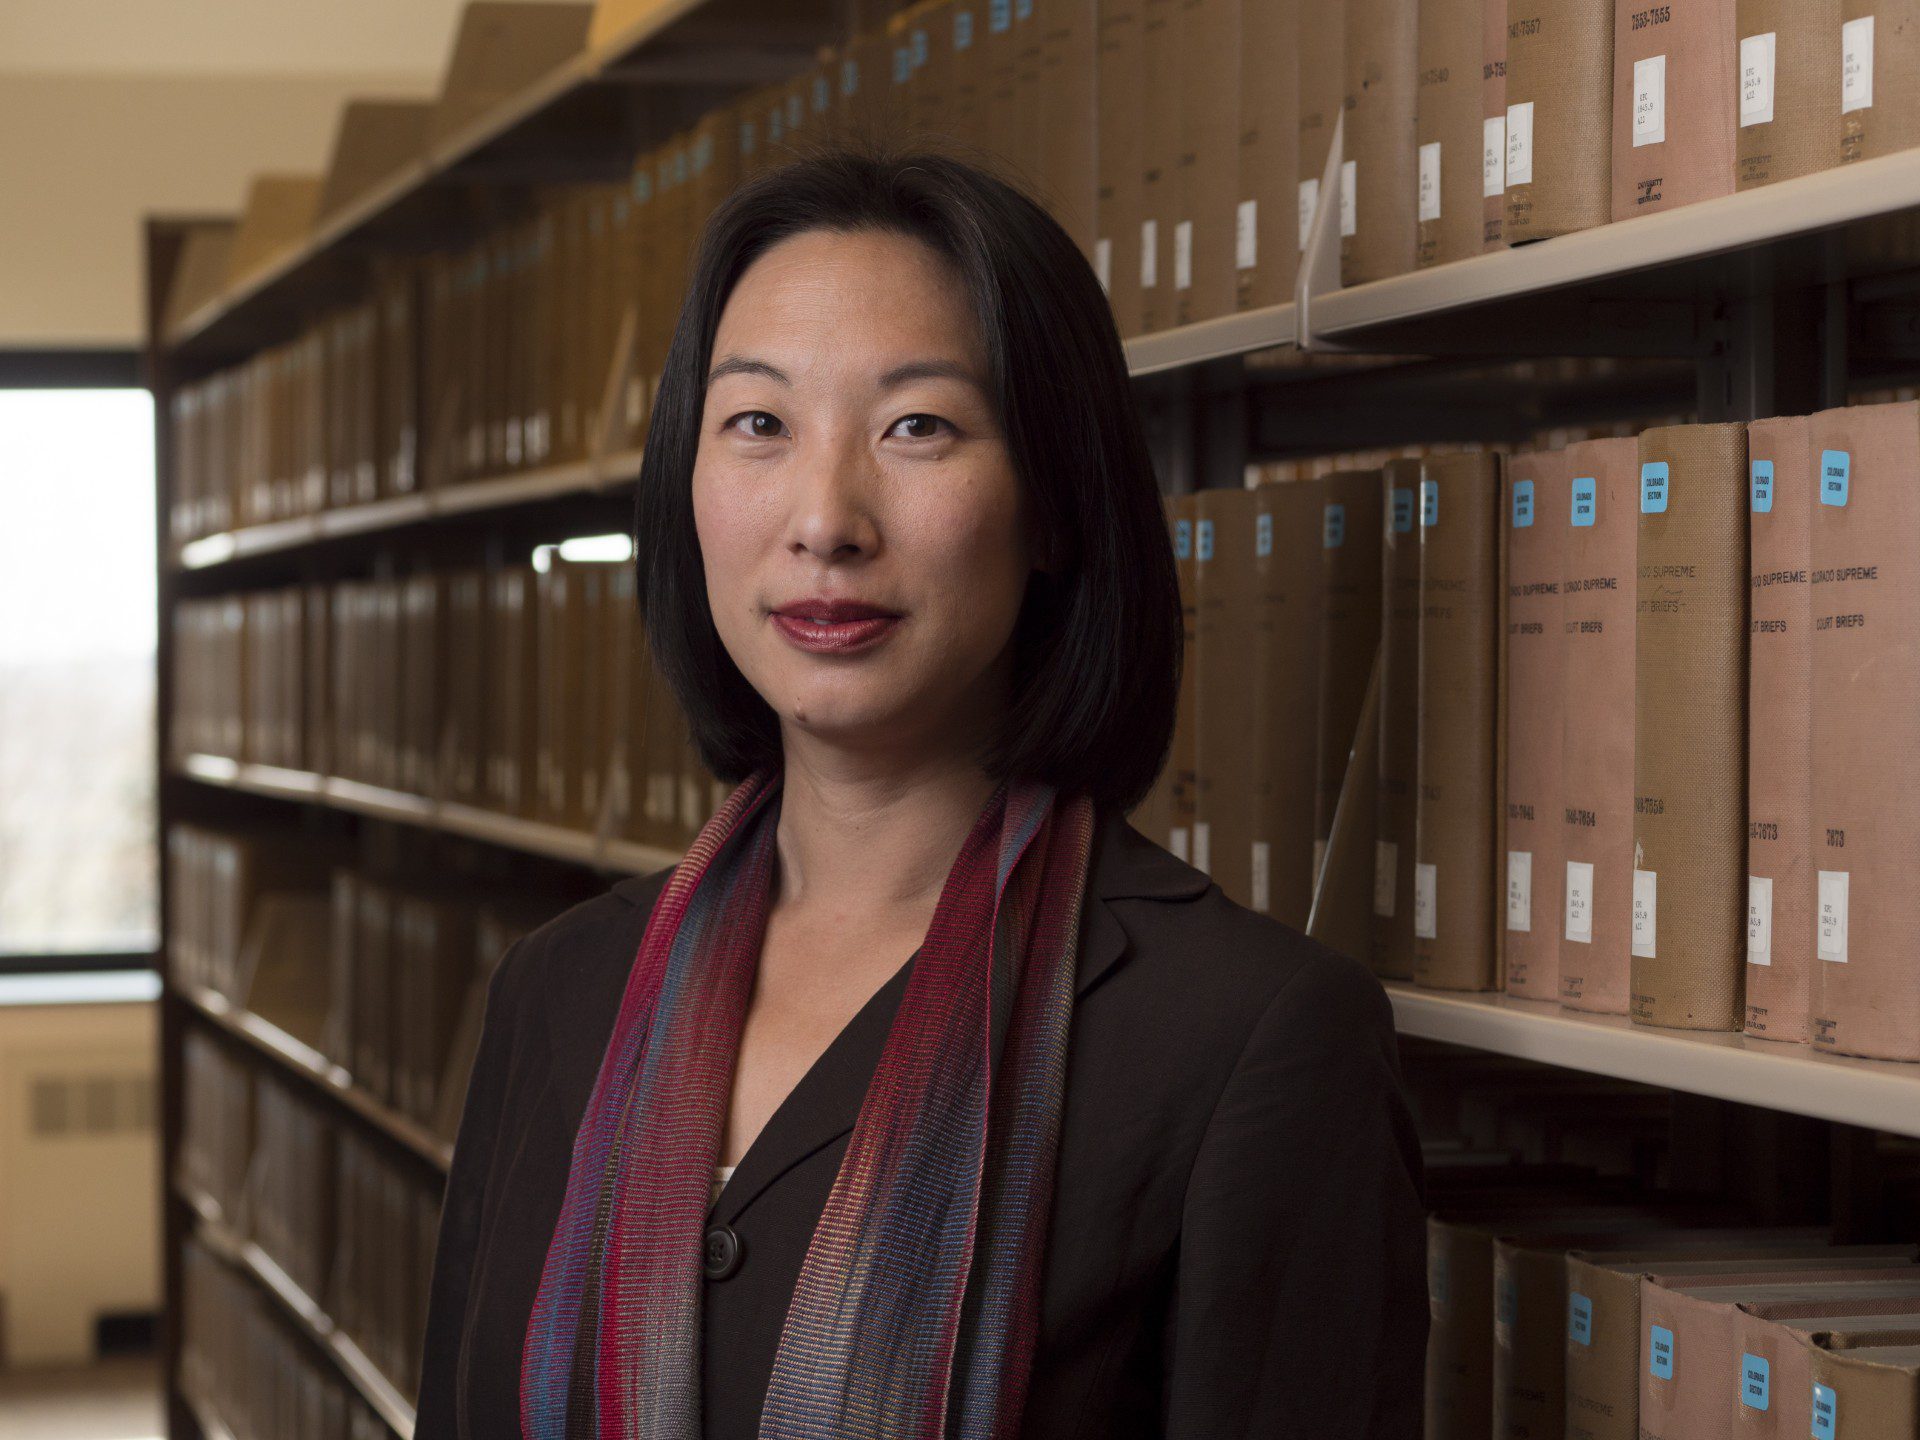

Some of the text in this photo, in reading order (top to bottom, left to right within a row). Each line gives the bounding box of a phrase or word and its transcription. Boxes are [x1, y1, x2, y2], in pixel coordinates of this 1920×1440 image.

[1646, 477, 1665, 487] COLORADO
[1647, 491, 1662, 500] SECTION
[1653, 565, 1696, 578] SUPREME
[1836, 566, 1878, 582] SUPREME
[1583, 578, 1617, 591] SUPREME
[1762, 570, 1807, 587] SUPREME
[1522, 583, 1559, 596] SUPREME
[1650, 600, 1679, 613] BRIEFS
[1581, 622, 1603, 633] BRIEFS
[1760, 621, 1787, 633] BRIEFS
[1835, 614, 1864, 628] BRIEFS
[1521, 622, 1543, 634] BRIEFS
